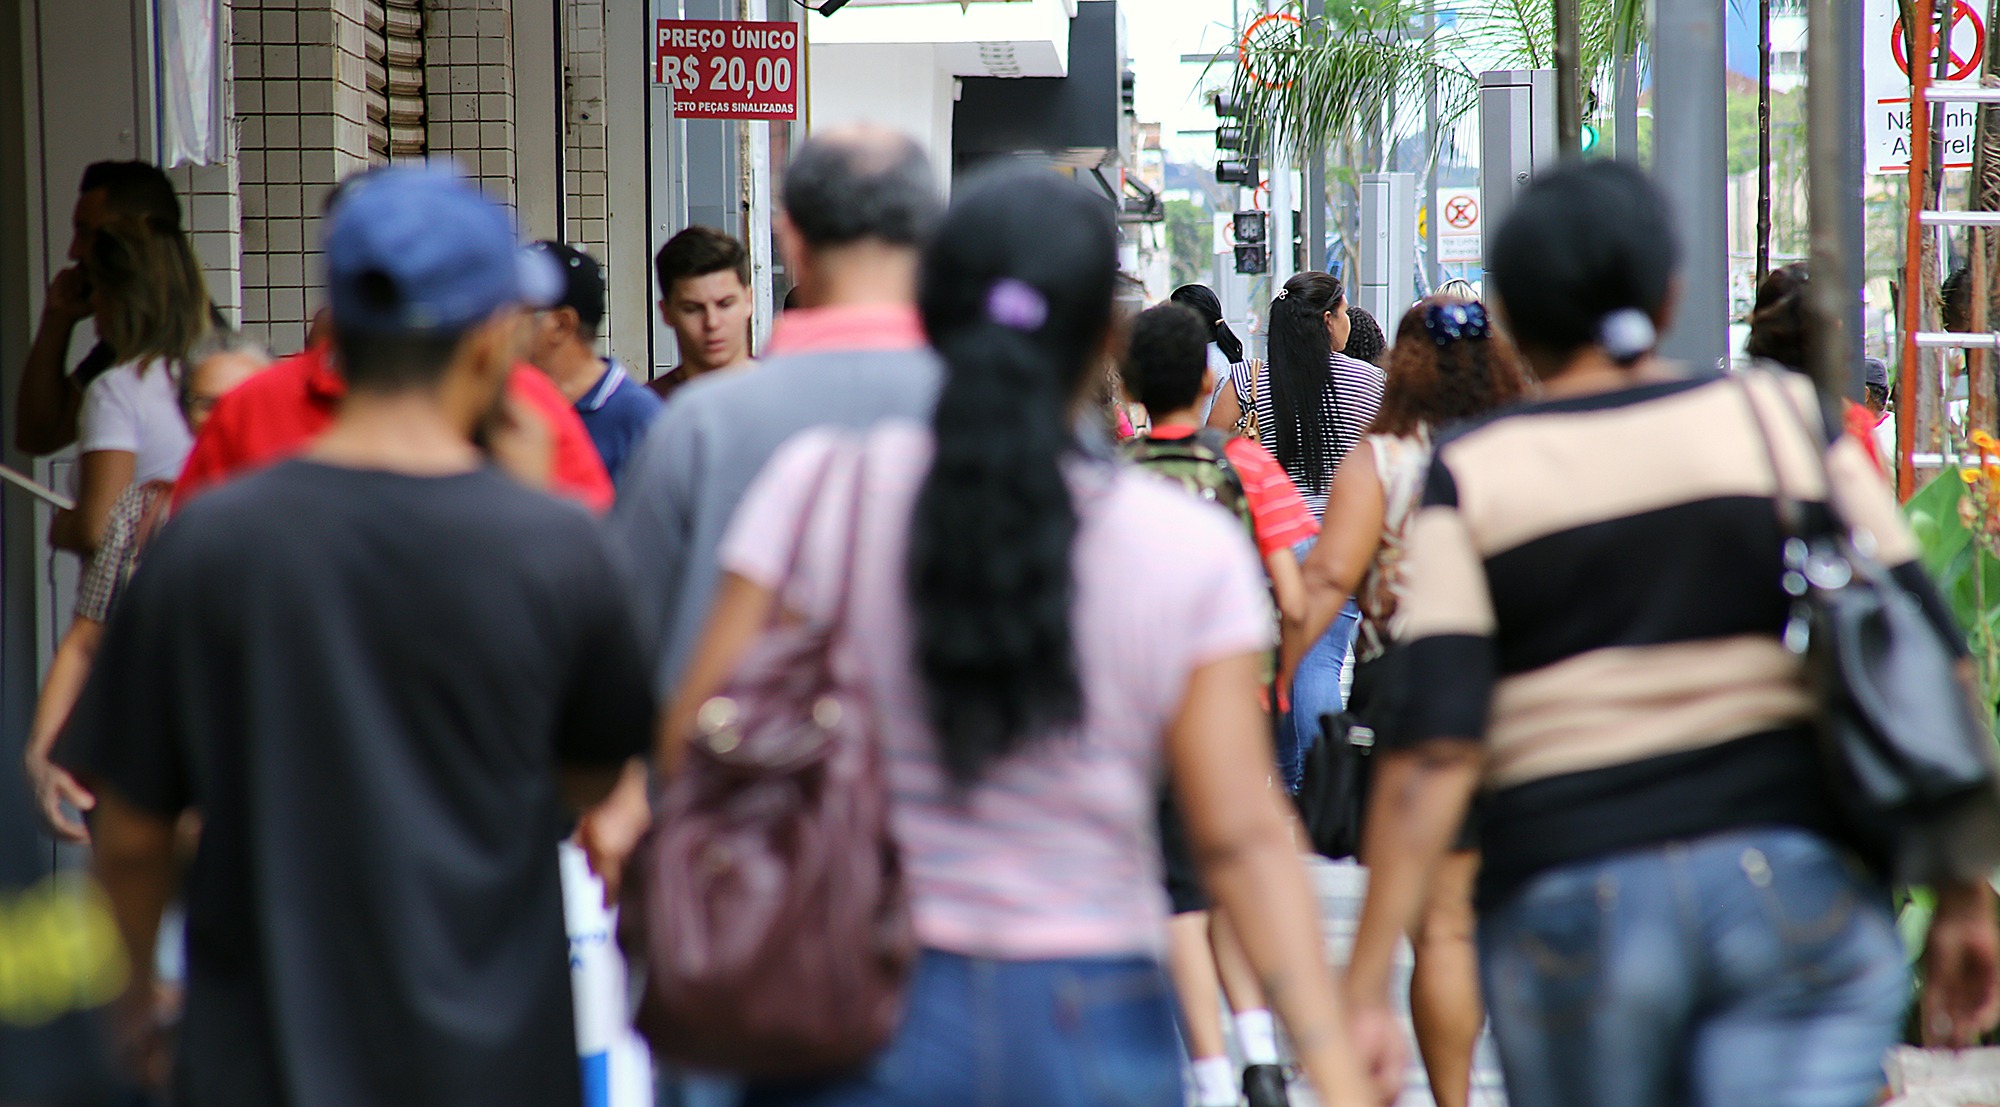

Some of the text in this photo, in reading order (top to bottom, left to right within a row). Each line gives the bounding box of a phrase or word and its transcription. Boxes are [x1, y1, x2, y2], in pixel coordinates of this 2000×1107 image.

[659, 25, 796, 52] PREÇO ÚNICO
[662, 54, 792, 99] R$ 20,00
[698, 102, 730, 114] PEÇAS
[731, 103, 794, 114] SINALIZADAS
